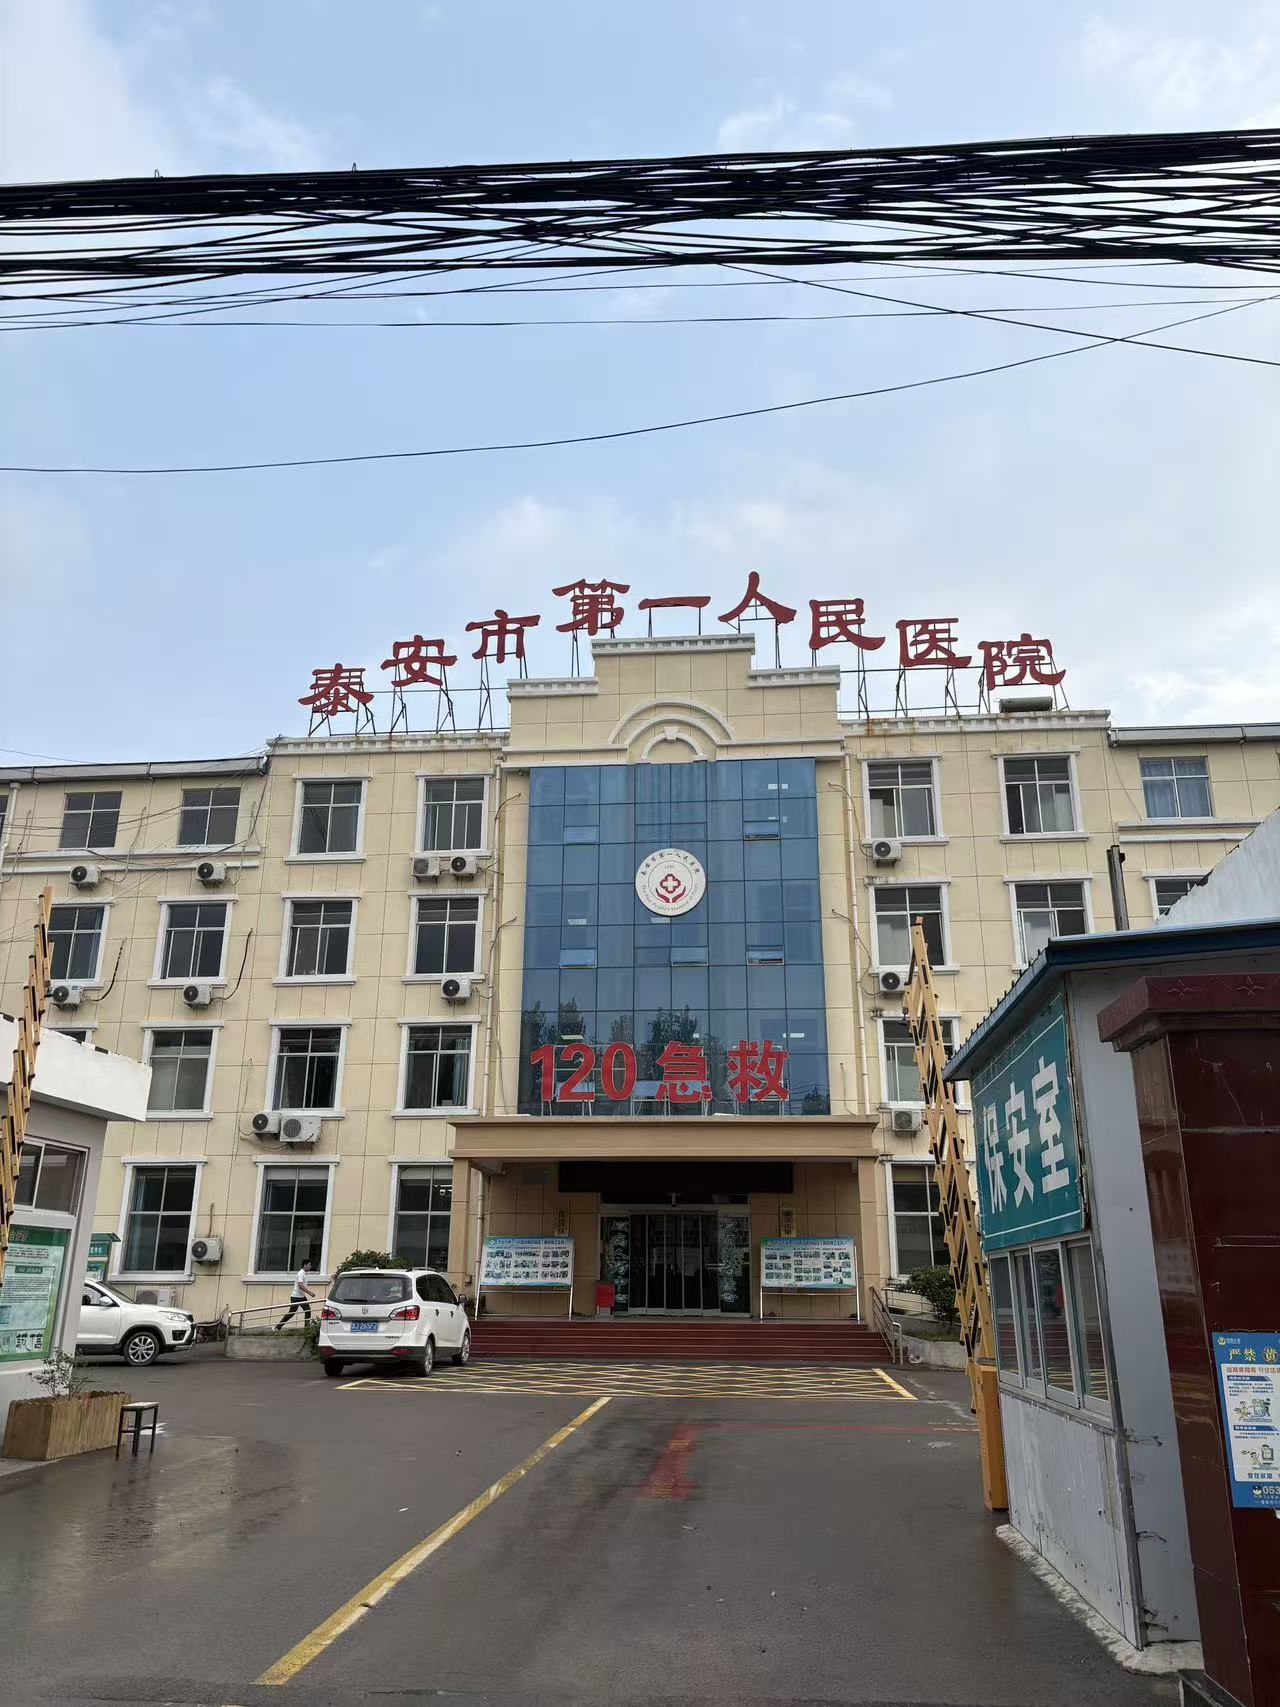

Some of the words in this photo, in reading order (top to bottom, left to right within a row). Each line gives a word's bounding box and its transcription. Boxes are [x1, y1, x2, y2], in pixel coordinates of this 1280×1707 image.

[298, 571, 1066, 717] 泰安市第一人民医院
[983, 1055, 1070, 1214] 保安室
[1229, 1347, 1256, 1362] 严禁
